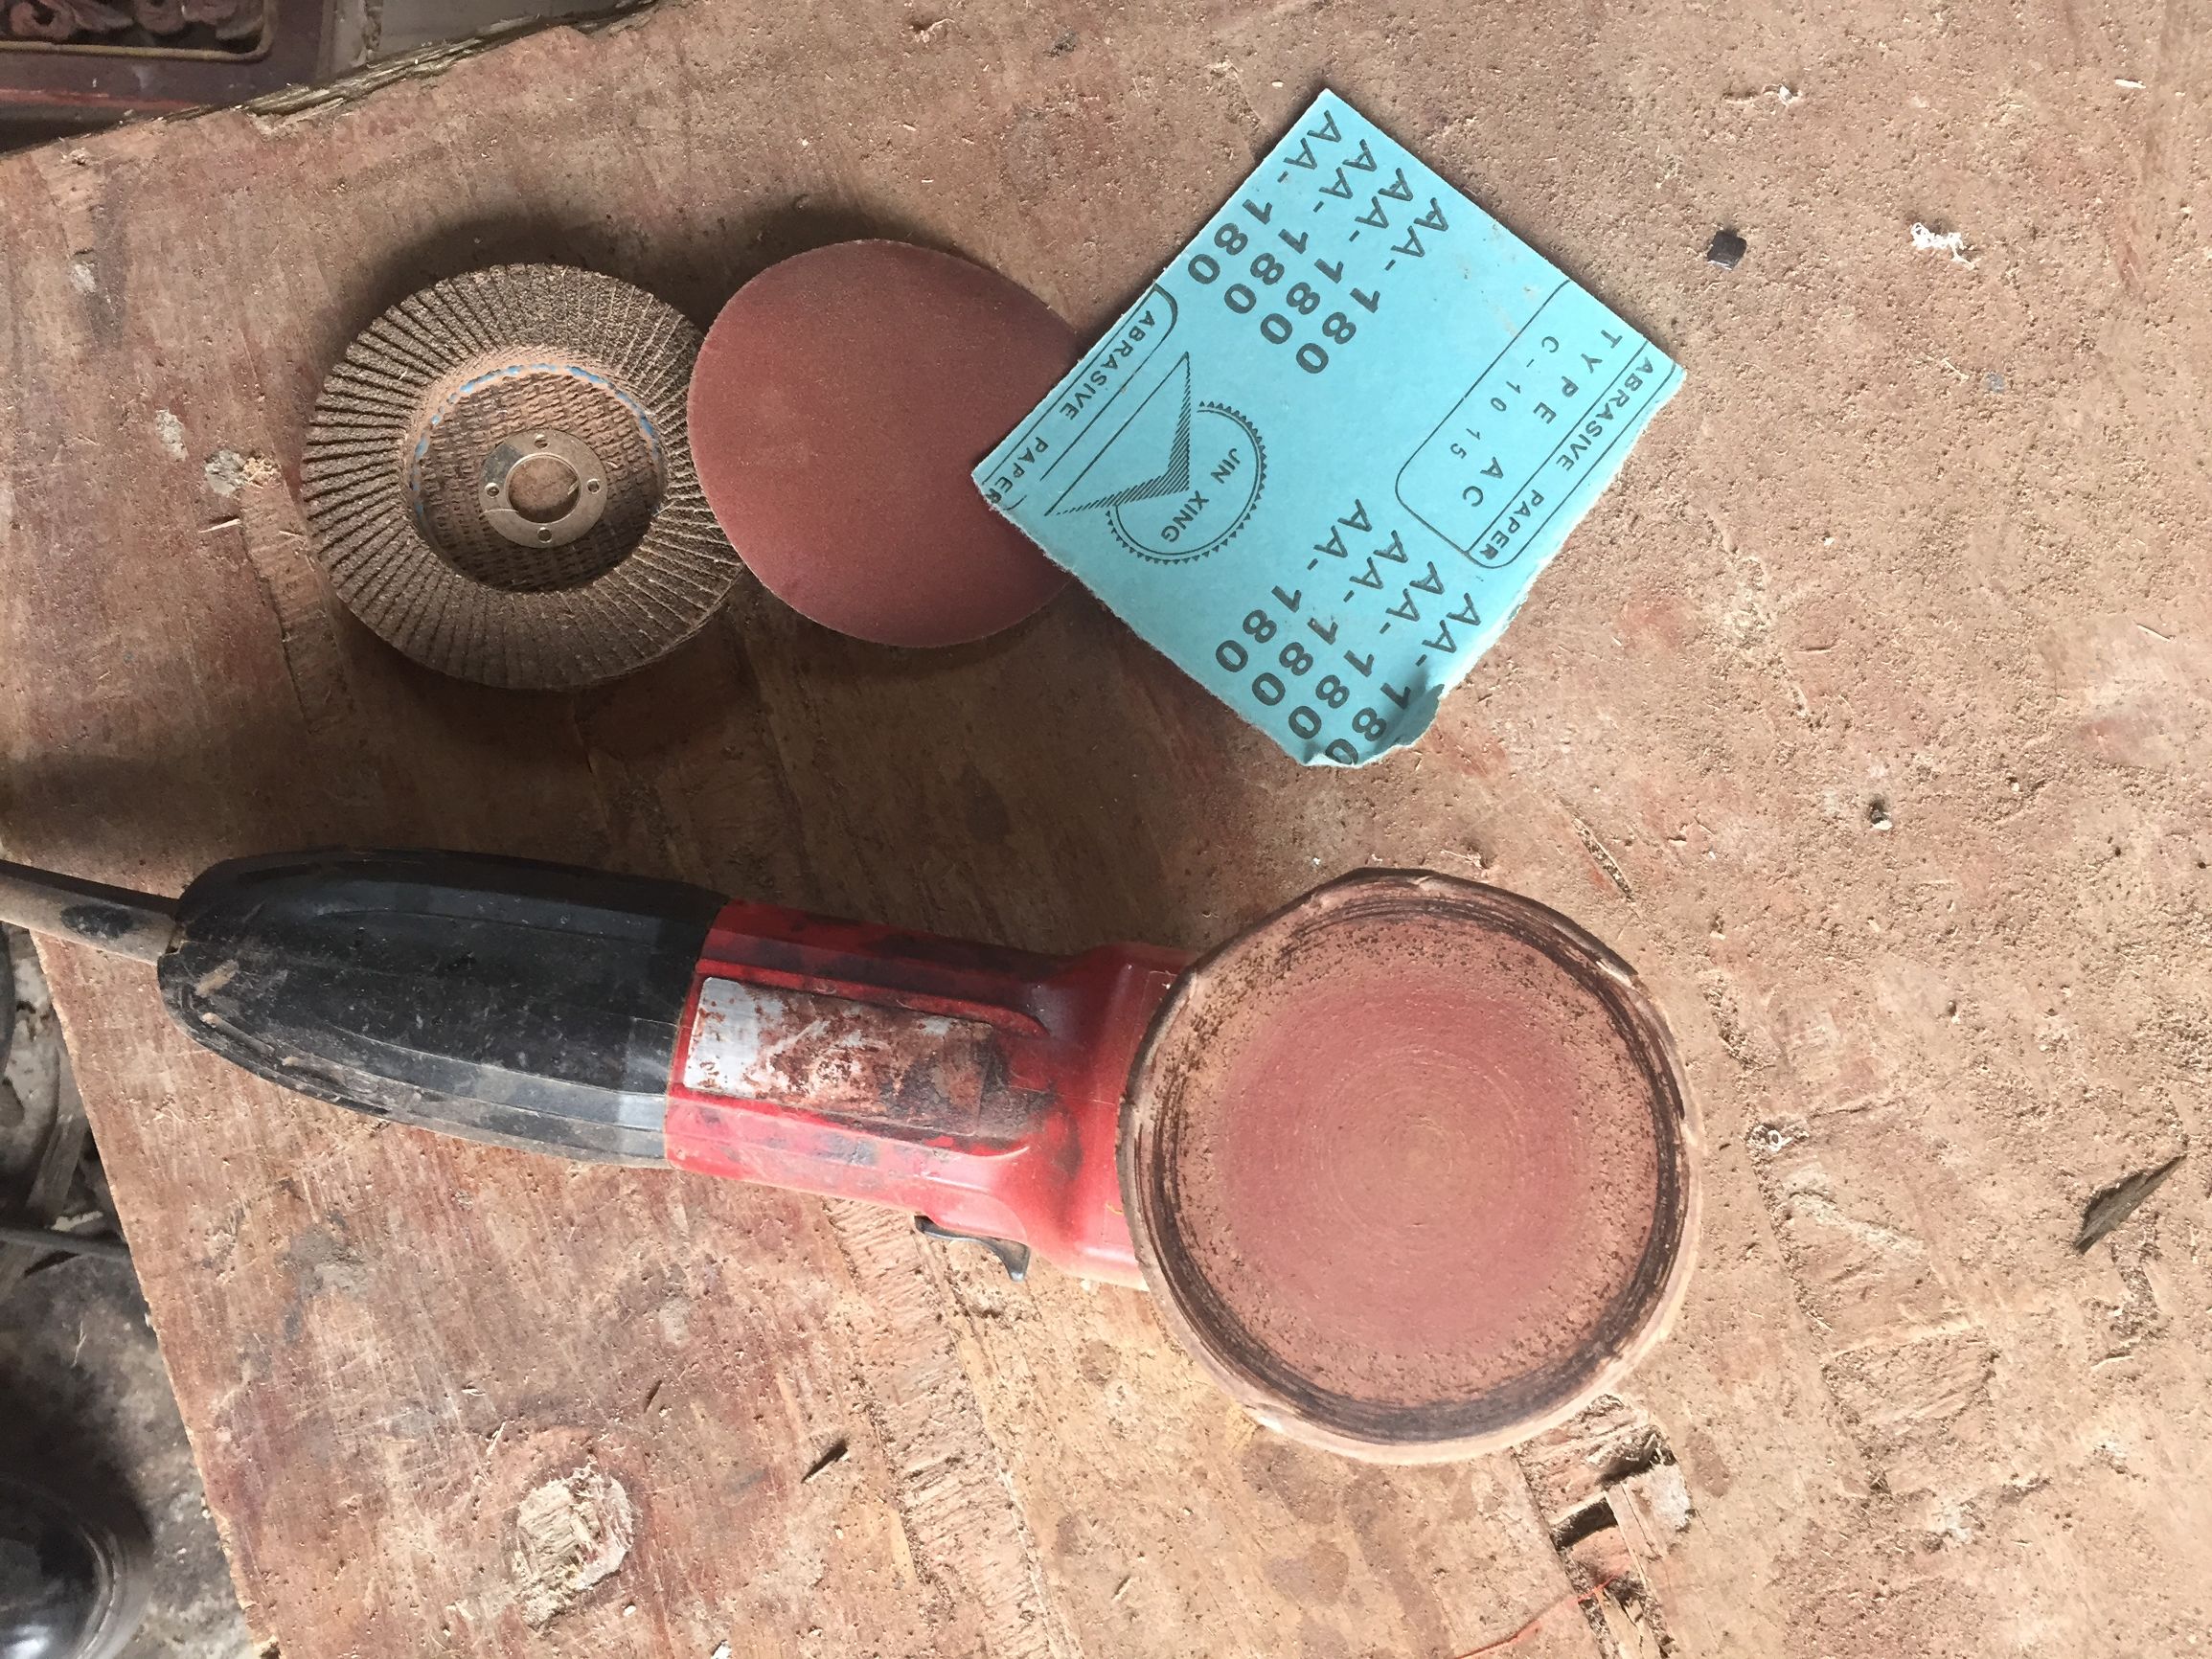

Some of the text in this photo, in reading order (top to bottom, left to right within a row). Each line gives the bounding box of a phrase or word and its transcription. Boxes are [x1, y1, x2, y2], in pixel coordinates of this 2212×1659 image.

[1059, 310, 1155, 420] ABRASIVE
[1462, 330, 1623, 508] TYPE AC
[1161, 448, 1241, 542] JIN XING
[1479, 356, 1653, 560] ABRASIVE PAPER
